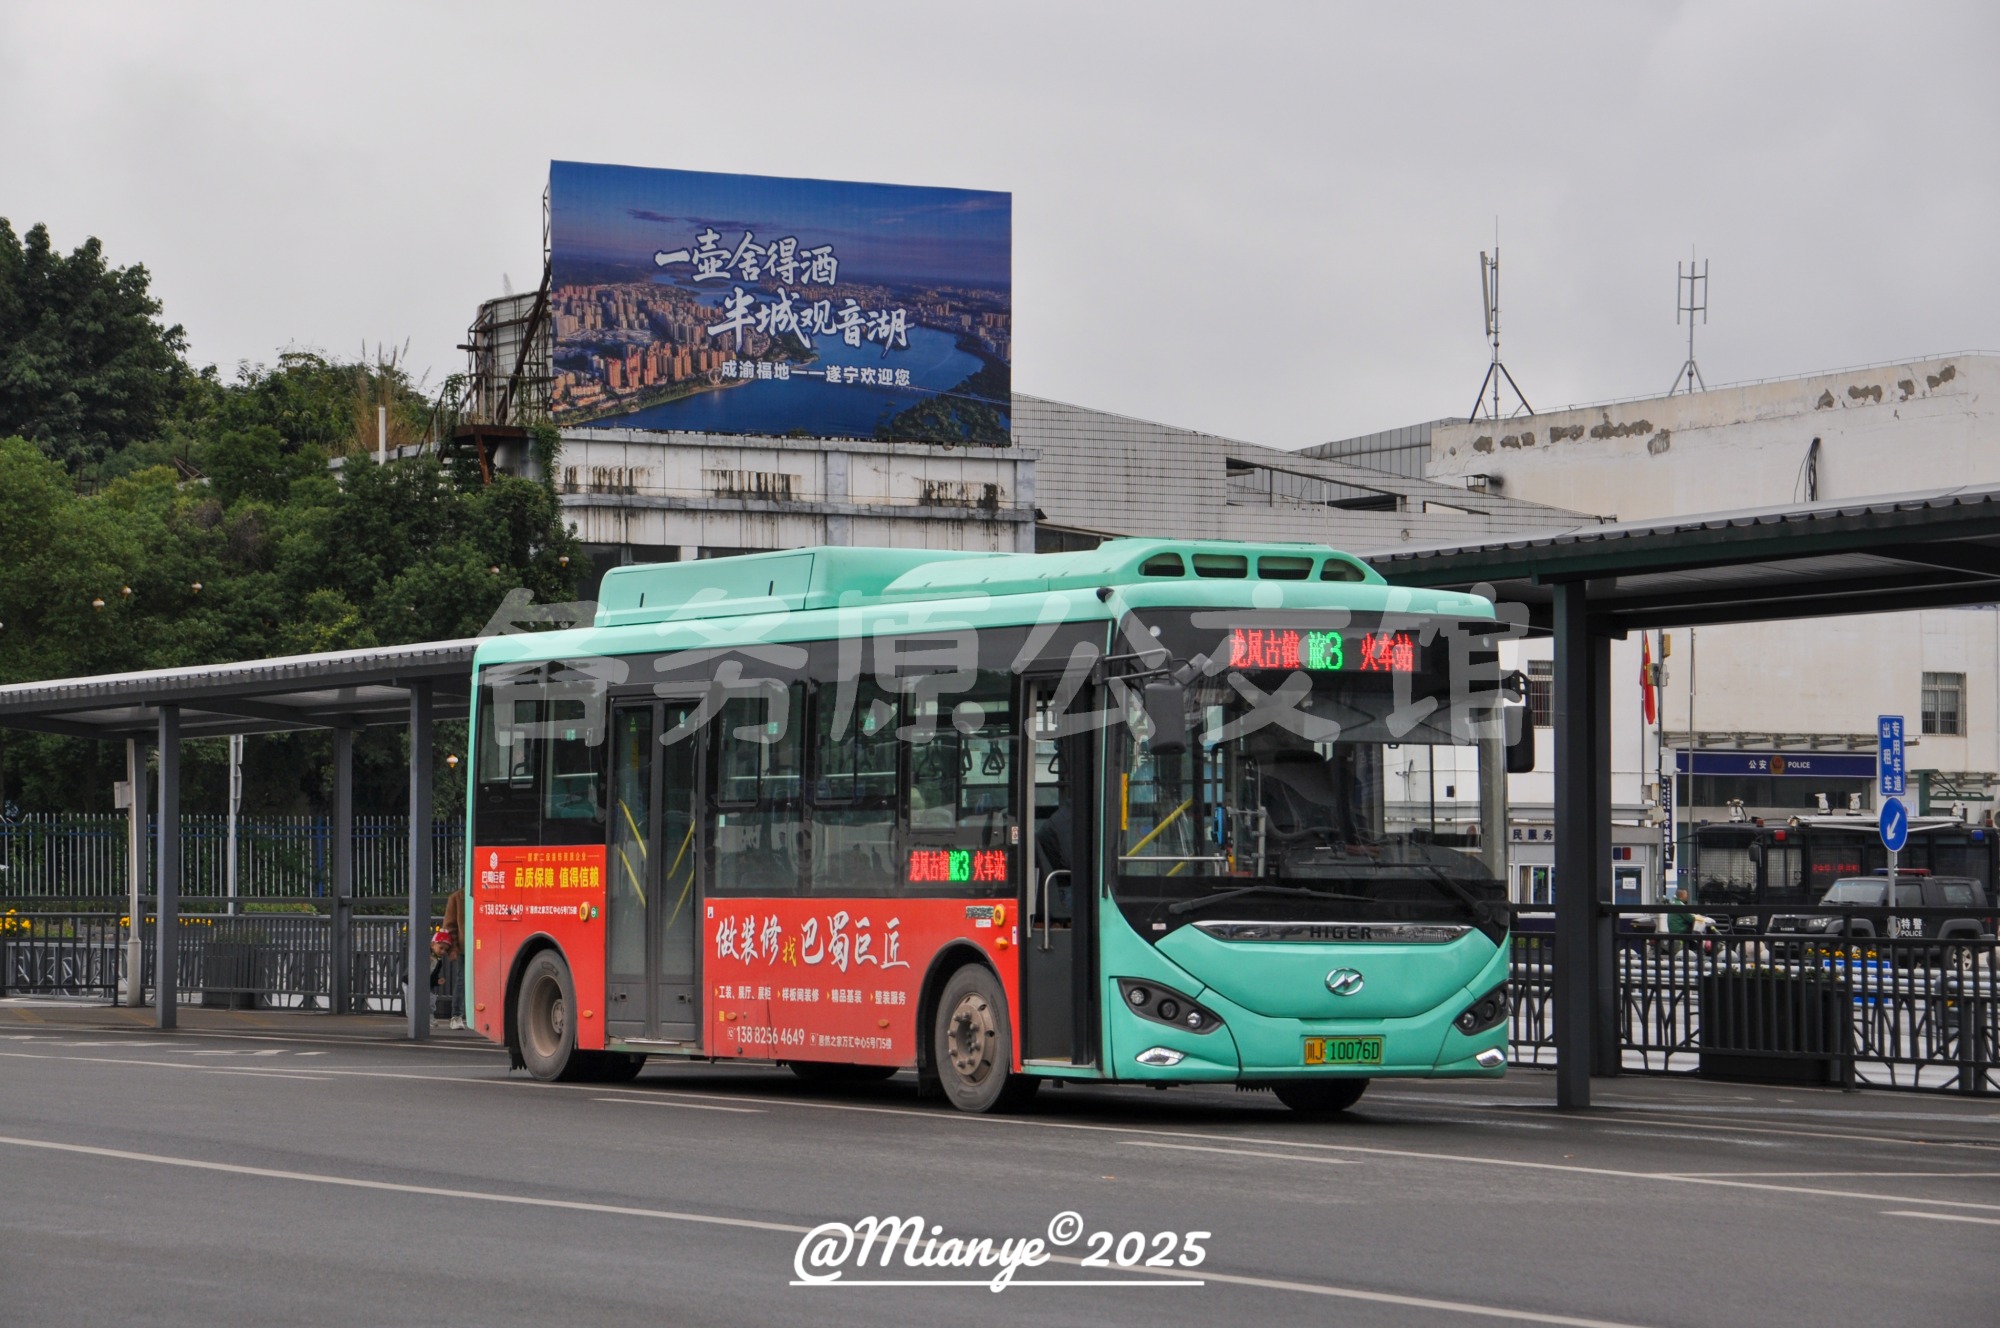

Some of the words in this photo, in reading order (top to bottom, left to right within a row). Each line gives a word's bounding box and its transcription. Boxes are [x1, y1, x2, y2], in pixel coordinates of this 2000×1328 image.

[654, 228, 838, 287] 一壶舍得酒
[708, 287, 914, 358] 半城观音湖
[1230, 628, 1300, 668] 龙凤古镇
[1308, 631, 1343, 670] 旅3
[1360, 633, 1414, 672] 火车站
[1748, 759, 1767, 770] 公安
[1788, 761, 1811, 769] POLICE
[1882, 722, 1892, 791] 出租车
[1892, 721, 1902, 791] 专用车道
[515, 867, 554, 888] 品质保障
[559, 867, 599, 888] 值得信赖
[973, 850, 1007, 881] 火车站
[1309, 925, 1373, 940] HIGER
[1901, 918, 1922, 930] 特警
[736, 1026, 752, 1044] 138
[754, 1027, 778, 1045] 8256
[781, 1028, 805, 1046] 4649
